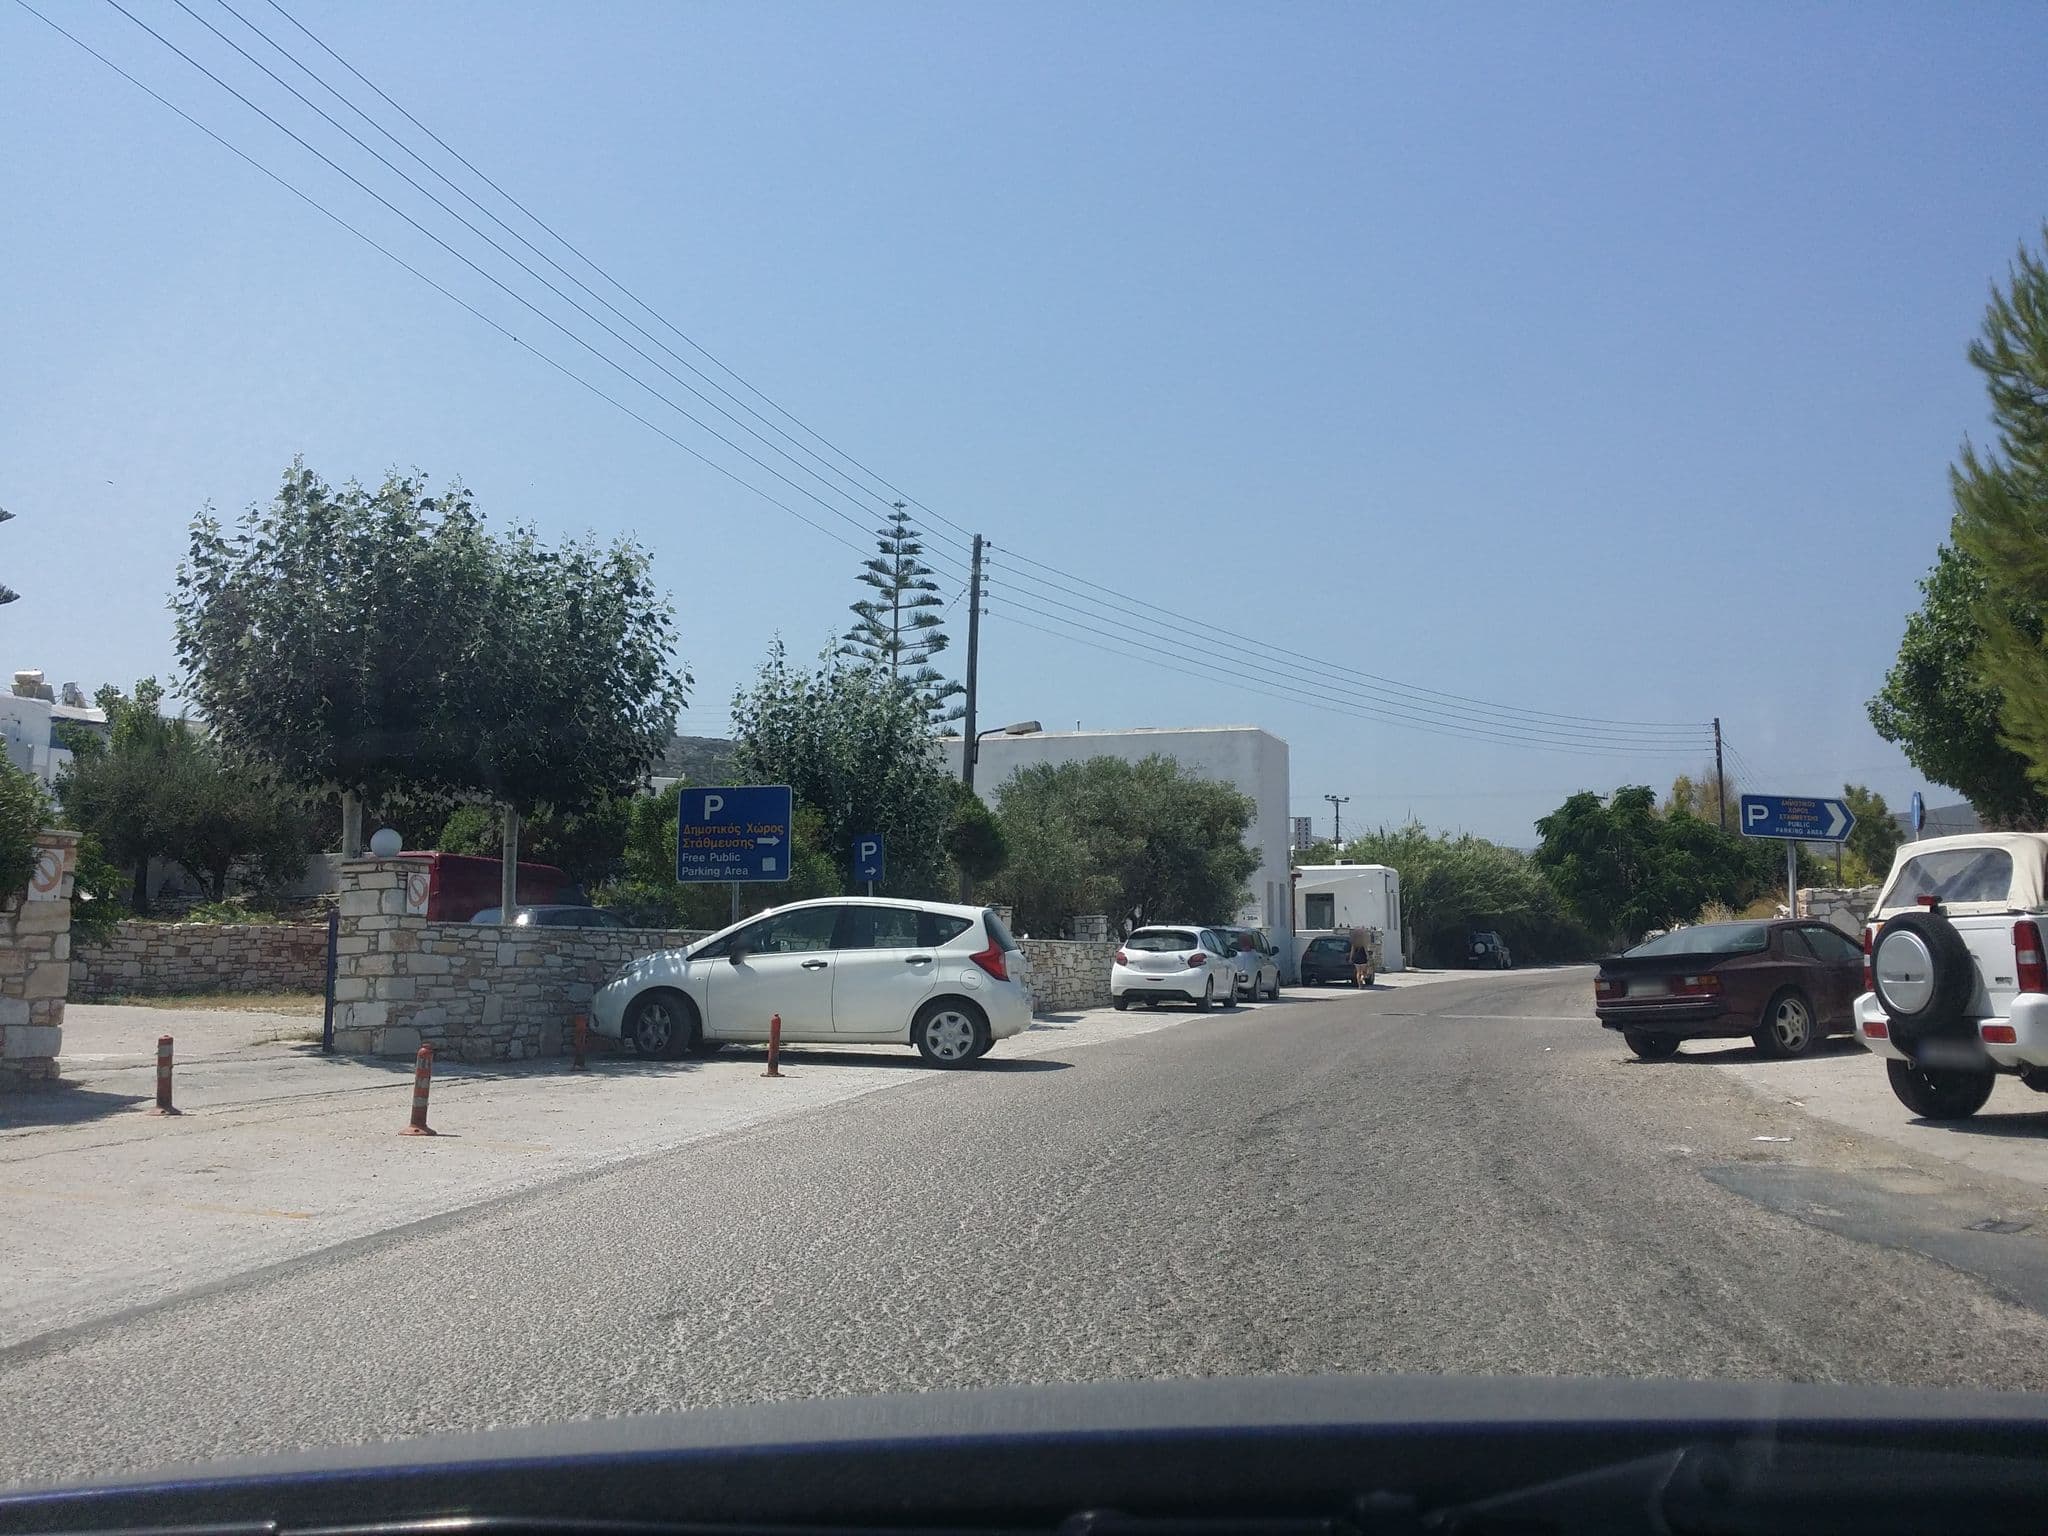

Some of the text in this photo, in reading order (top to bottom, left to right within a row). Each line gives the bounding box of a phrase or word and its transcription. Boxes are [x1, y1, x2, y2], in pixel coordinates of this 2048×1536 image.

[704, 795, 724, 820] P
[1748, 804, 1769, 826] P
[683, 823, 784, 836] Δημοτικός Χώρος
[683, 837, 755, 849] Στάθμευσης
[682, 852, 741, 862] Free Public
[861, 842, 877, 862] P
[681, 866, 748, 877] Parking Area
